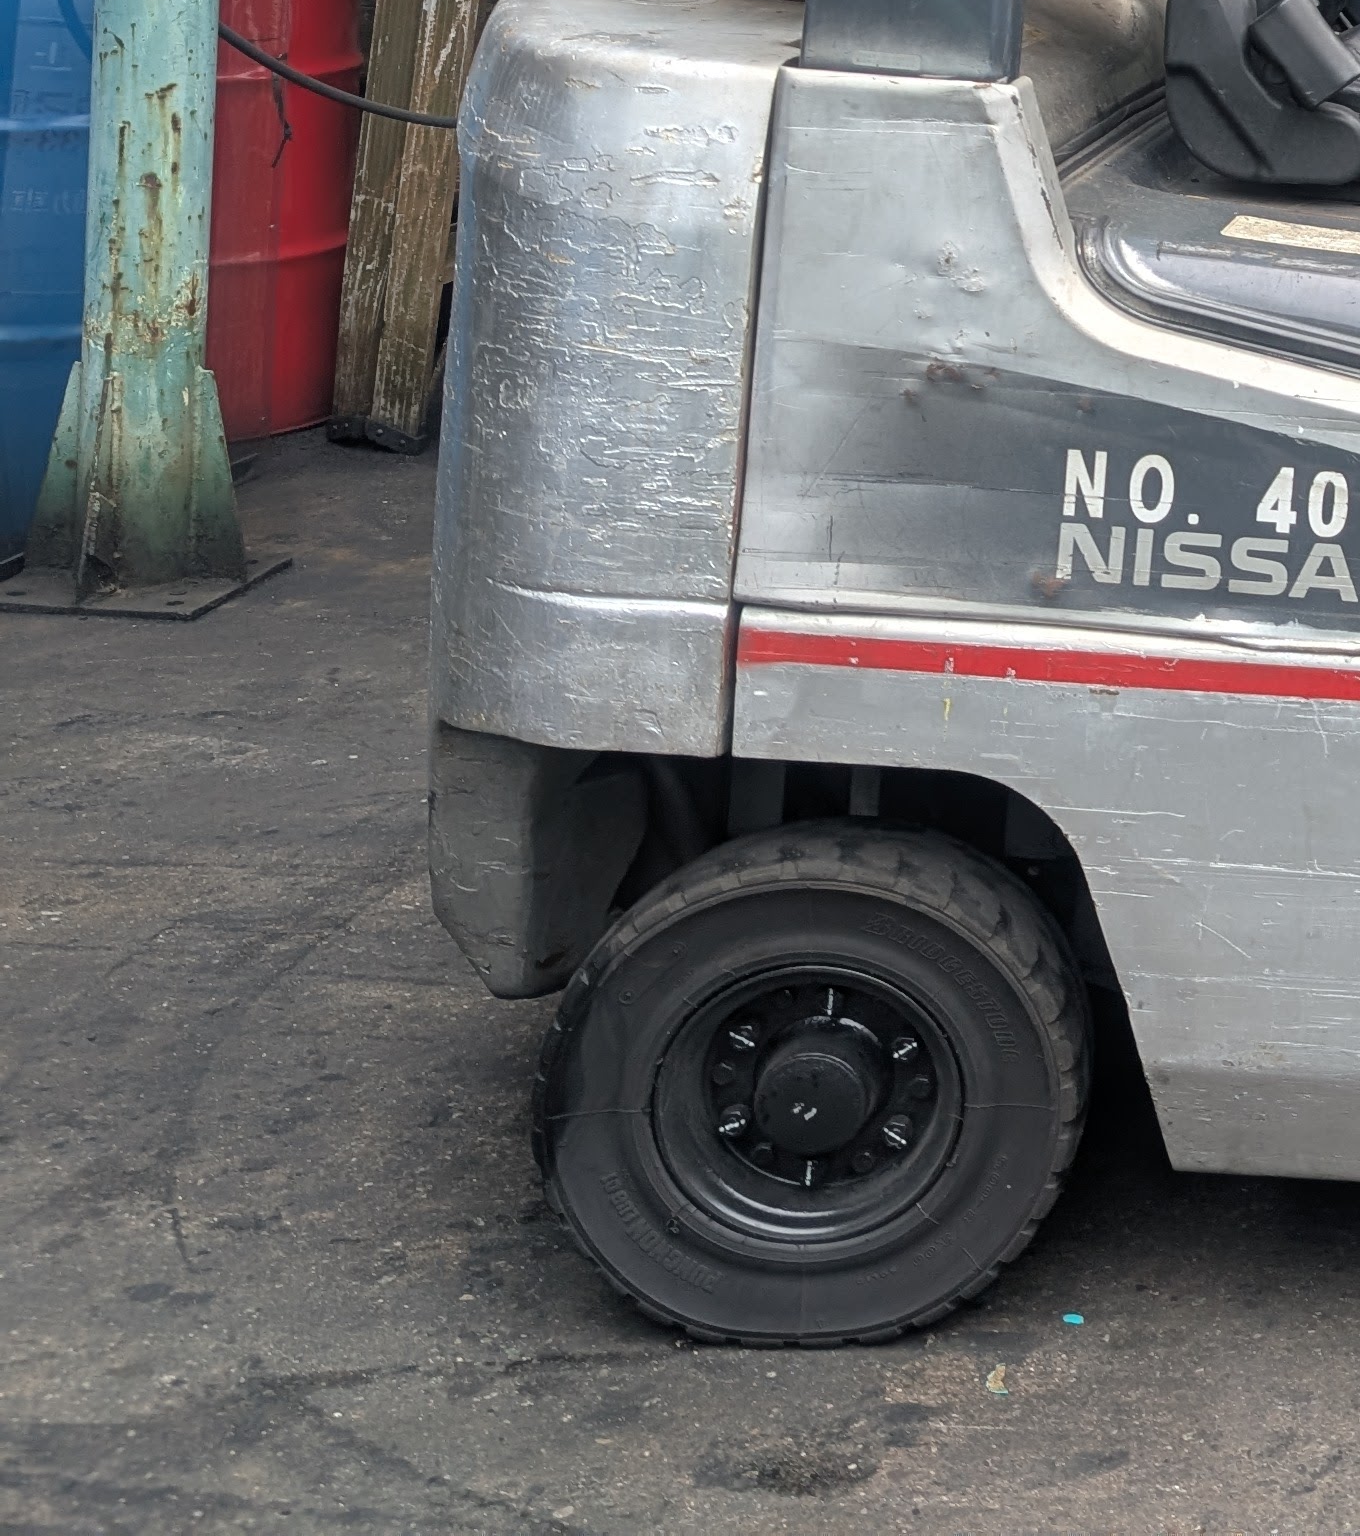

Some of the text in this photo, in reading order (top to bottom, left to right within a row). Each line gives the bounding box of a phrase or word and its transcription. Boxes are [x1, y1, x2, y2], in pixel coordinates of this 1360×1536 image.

[1062, 448, 1351, 538] NO. 40
[859, 911, 1021, 1063] BRIDGESTONE
